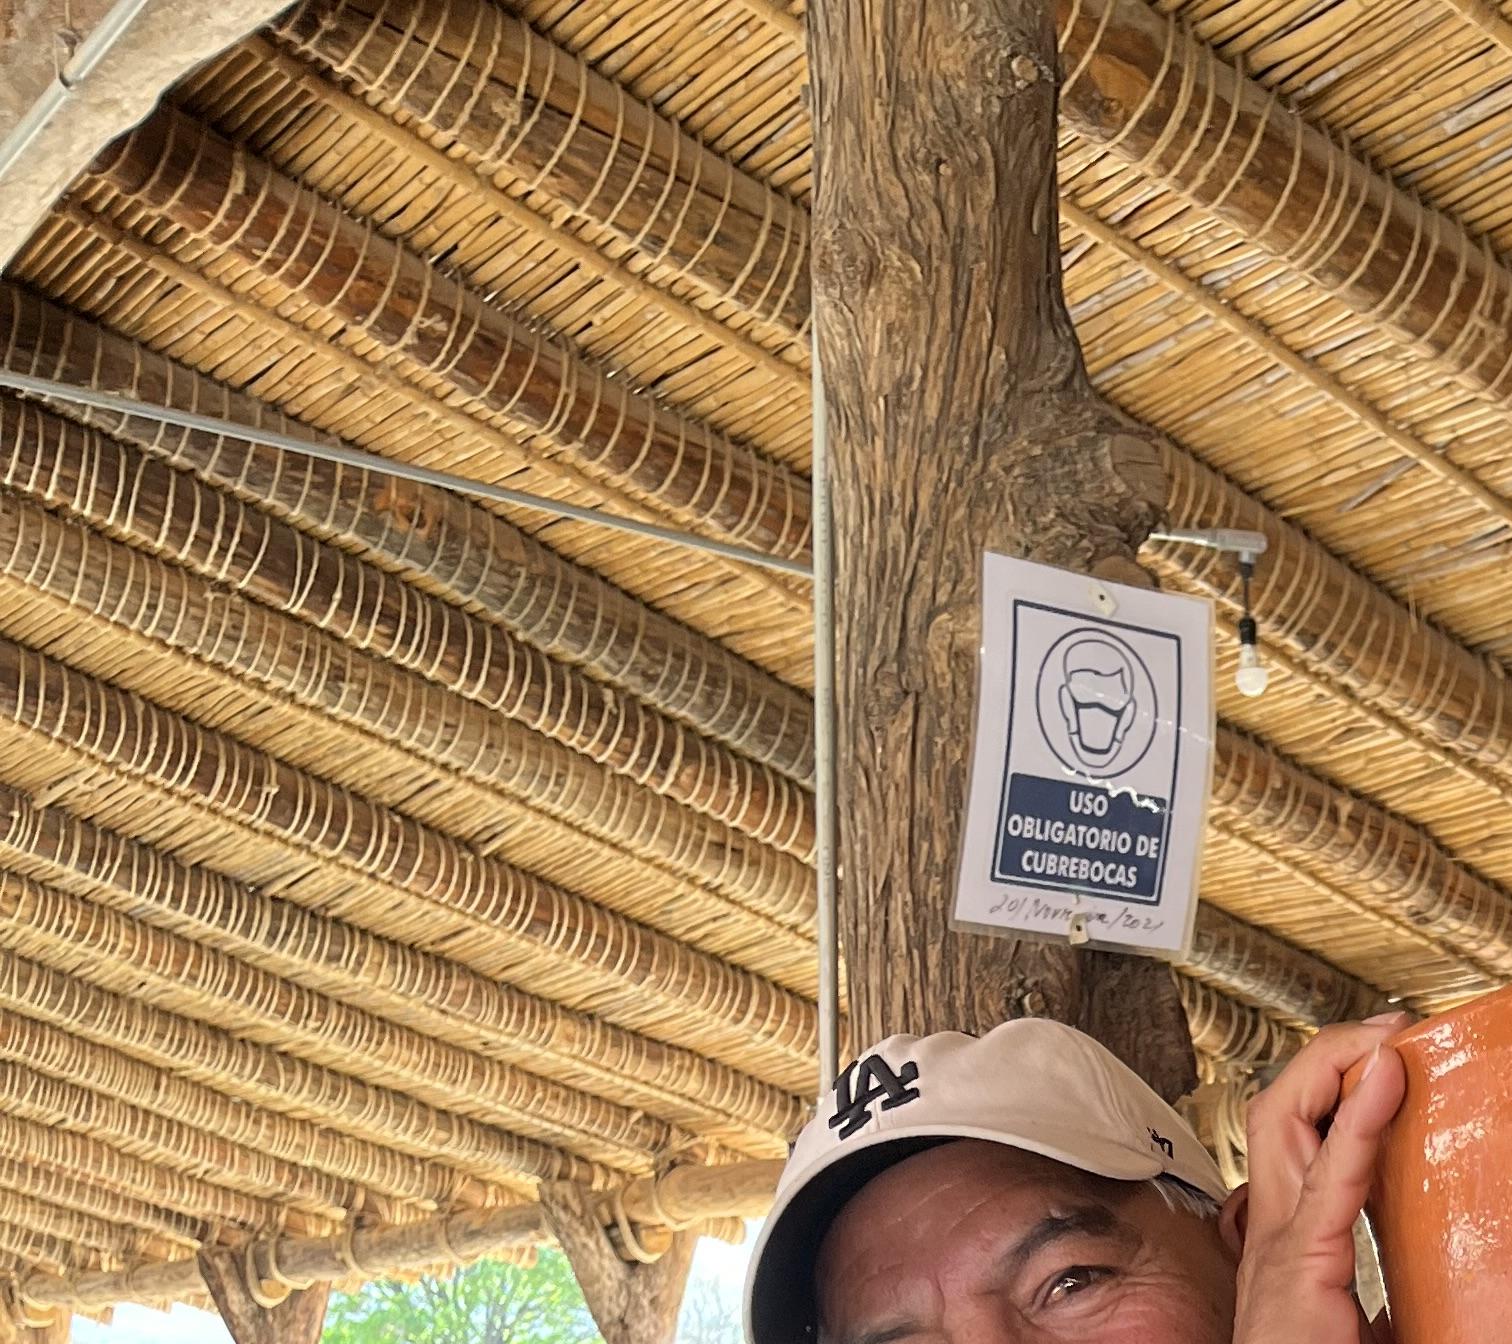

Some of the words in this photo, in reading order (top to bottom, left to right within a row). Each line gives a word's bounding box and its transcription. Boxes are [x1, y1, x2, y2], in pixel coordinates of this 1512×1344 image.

[1069, 790, 1109, 817] USO
[1007, 814, 1132, 854] OBLIGATORIO
[1135, 835, 1160, 858] DE
[1021, 850, 1138, 888] CUBREBOCAS
[828, 1053, 920, 1141] LA
